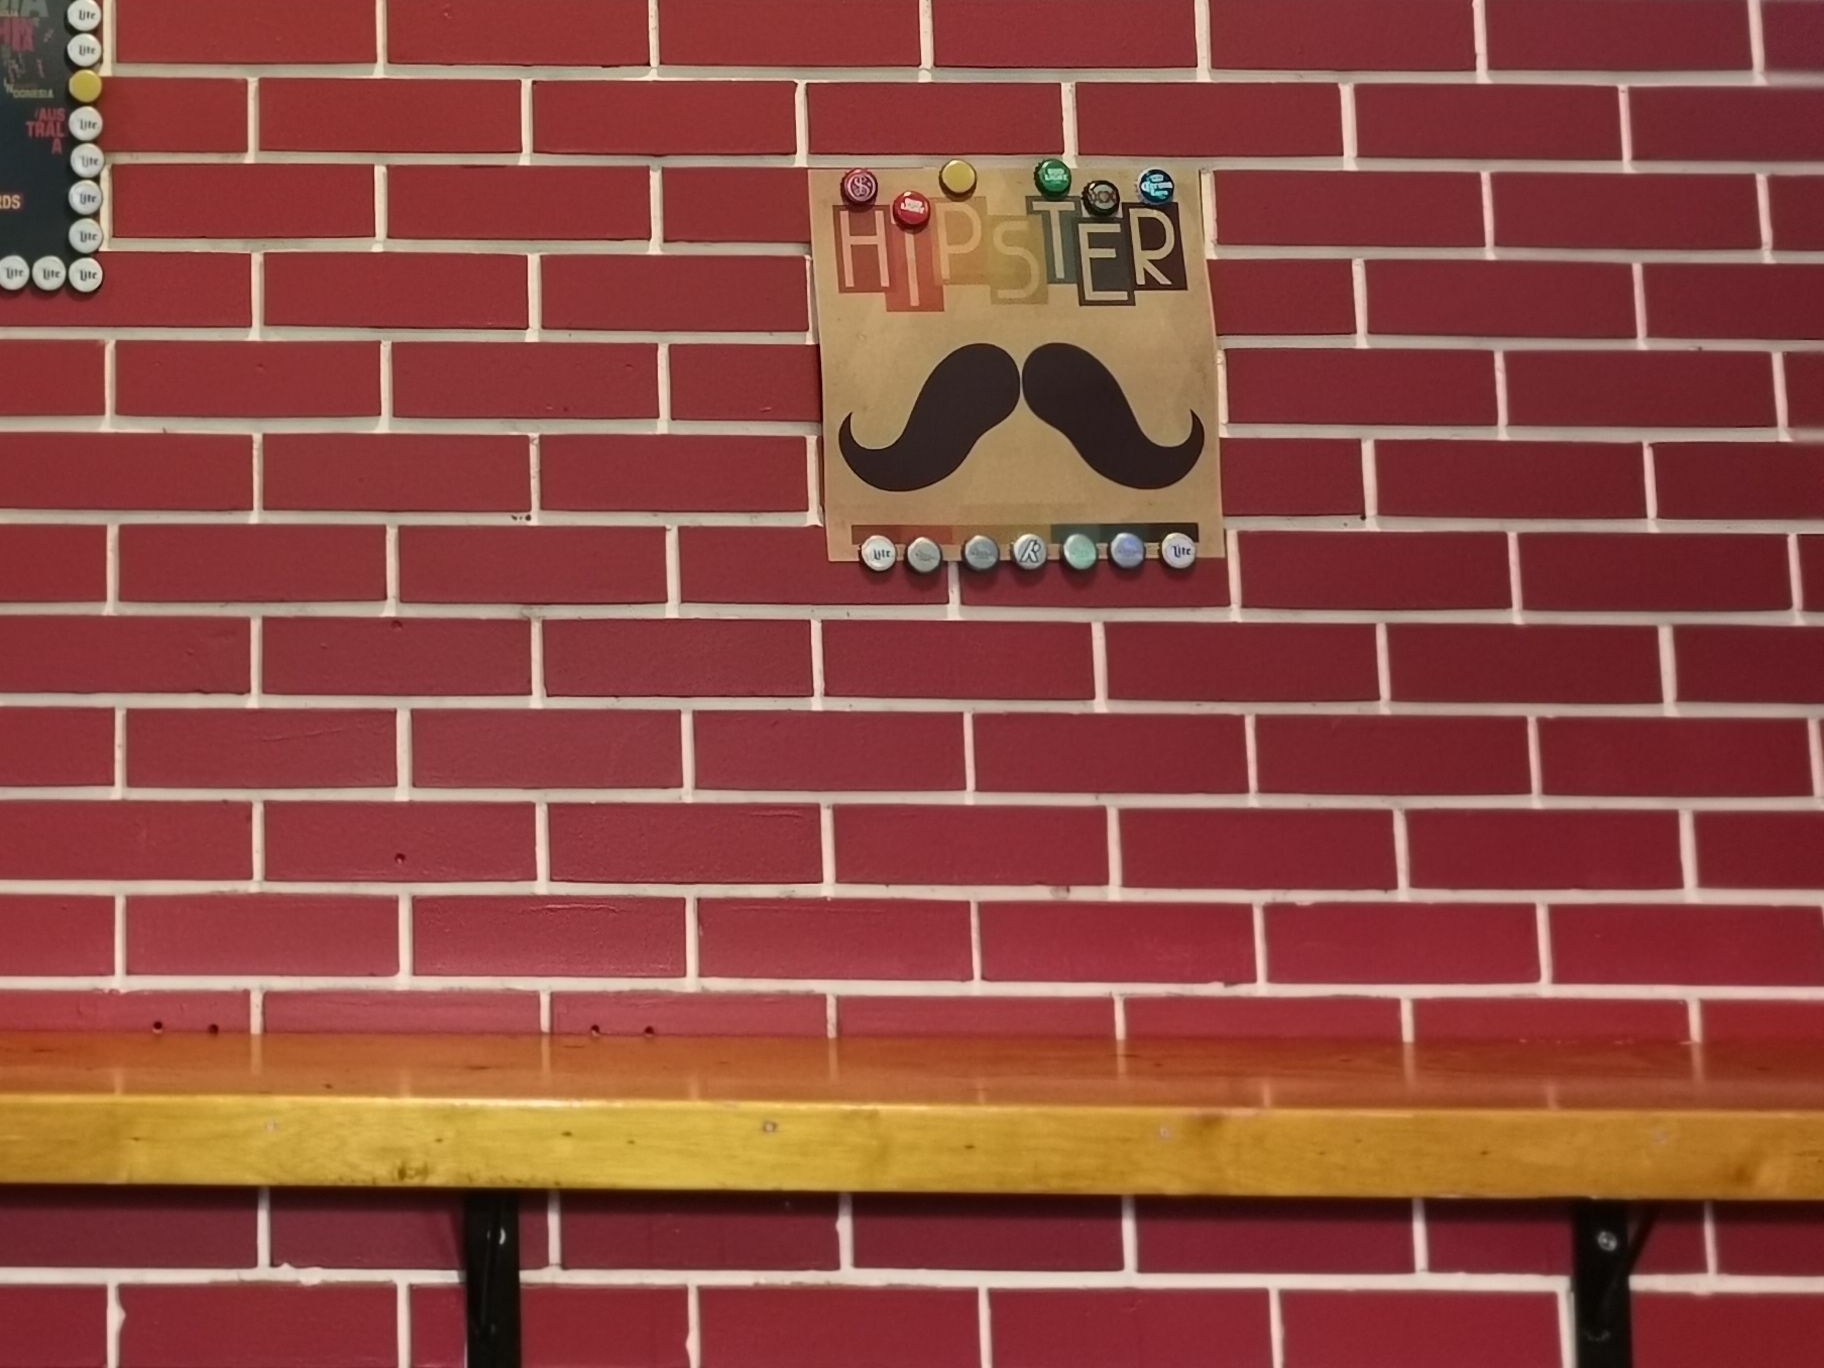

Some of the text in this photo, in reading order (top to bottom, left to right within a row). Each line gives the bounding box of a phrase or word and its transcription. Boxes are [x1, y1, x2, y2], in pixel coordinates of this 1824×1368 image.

[839, 200, 1175, 308] HIPSTER
[873, 549, 891, 561] Lite
[1172, 545, 1192, 558] Lite
